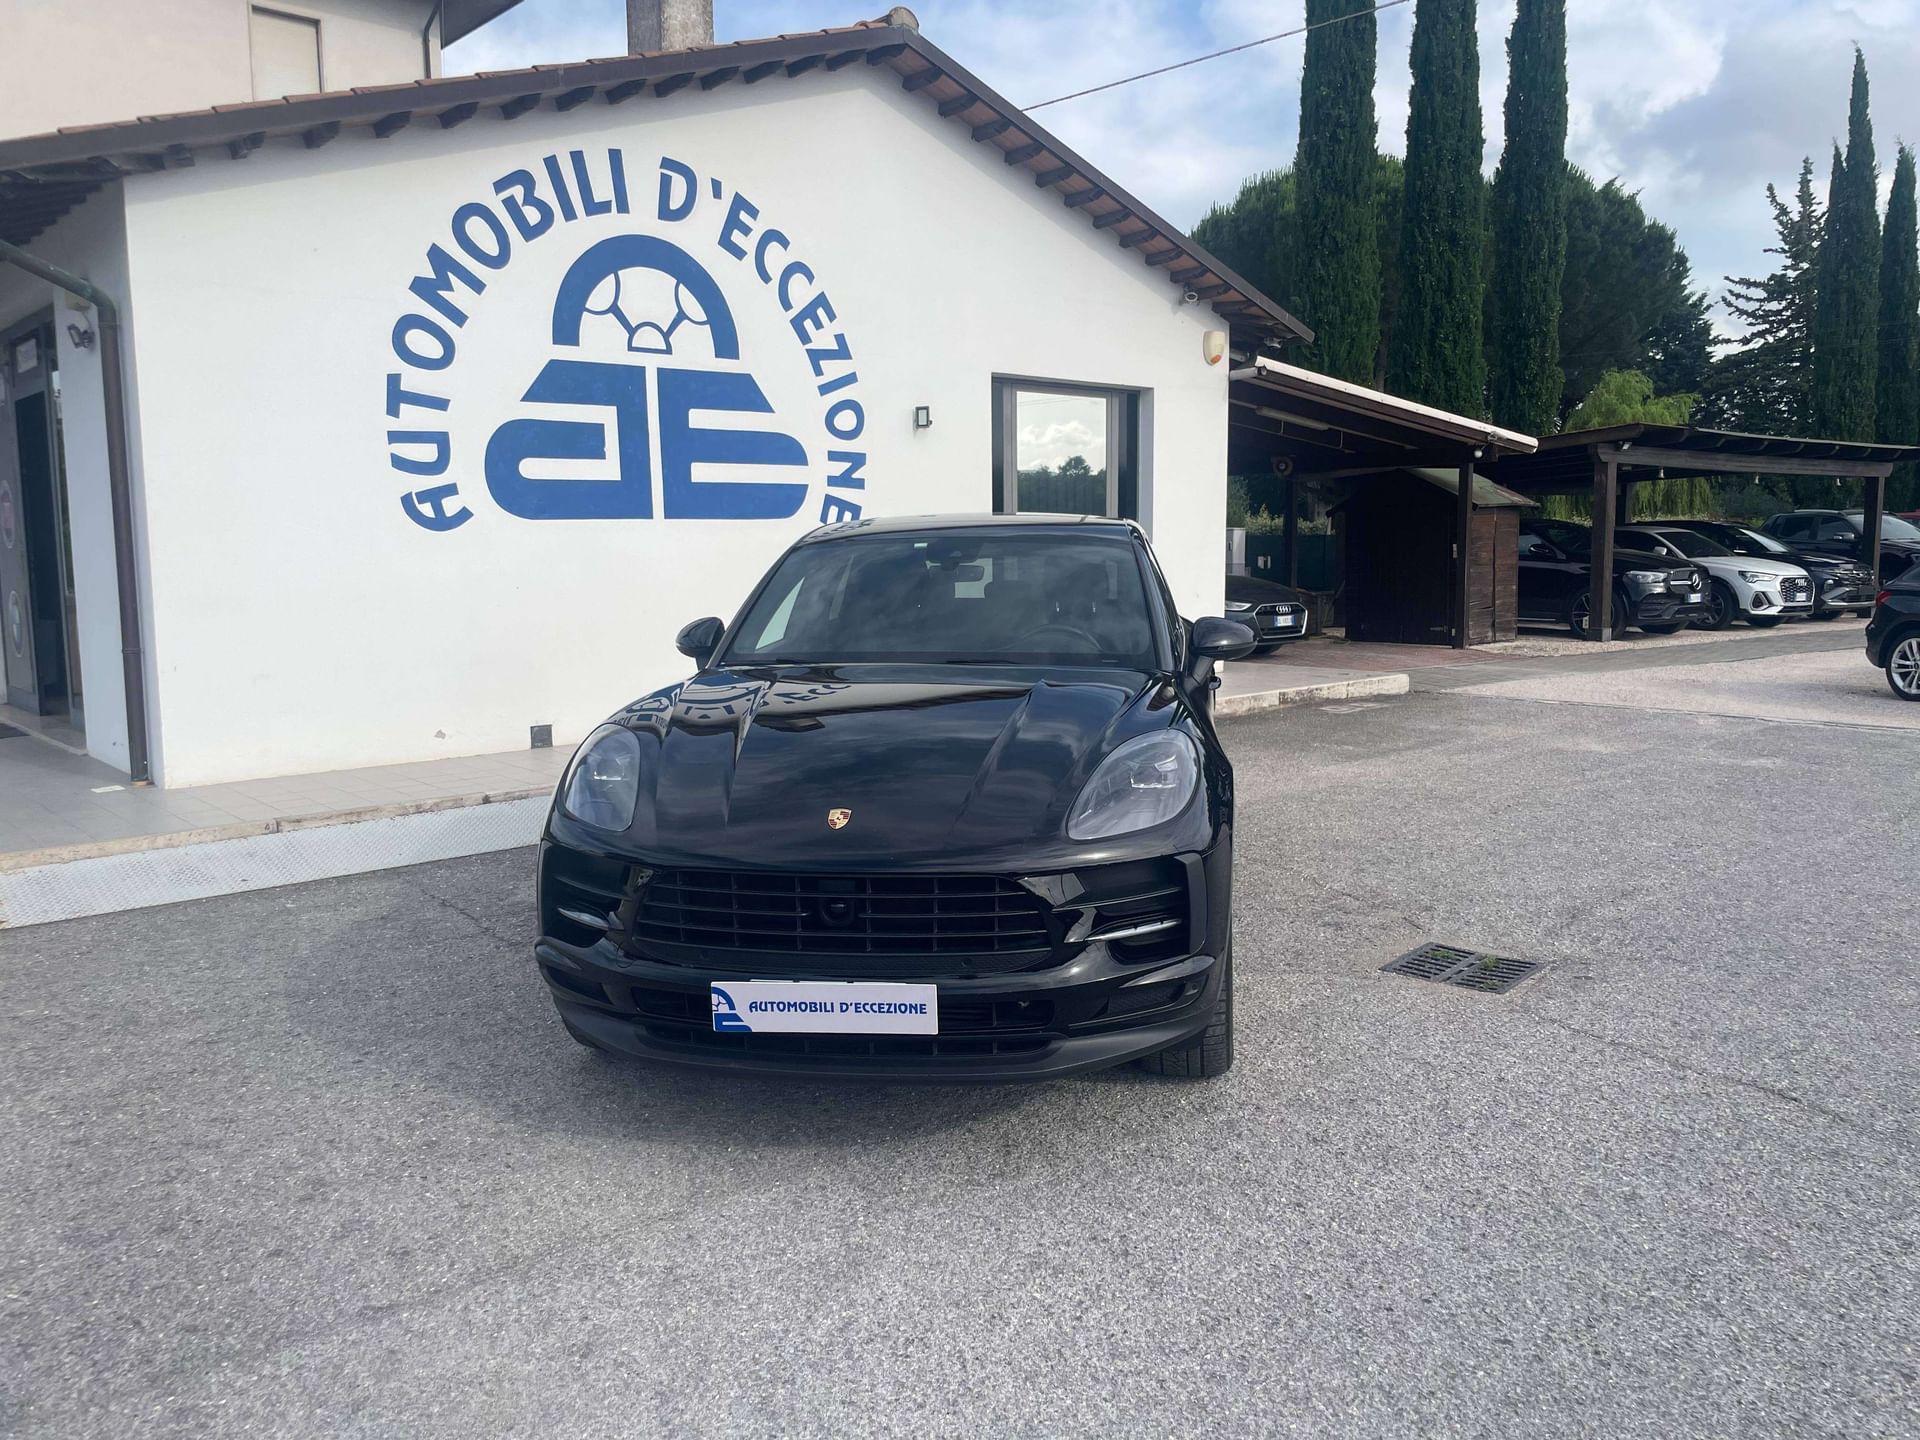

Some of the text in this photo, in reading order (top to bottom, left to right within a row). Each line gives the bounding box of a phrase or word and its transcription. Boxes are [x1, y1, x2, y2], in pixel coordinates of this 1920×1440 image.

[386, 148, 867, 532] AUTOMOBILI D'ECCEZIONE
[749, 1001, 928, 1015] AUTOMOBILI D'ECCEZIONE
